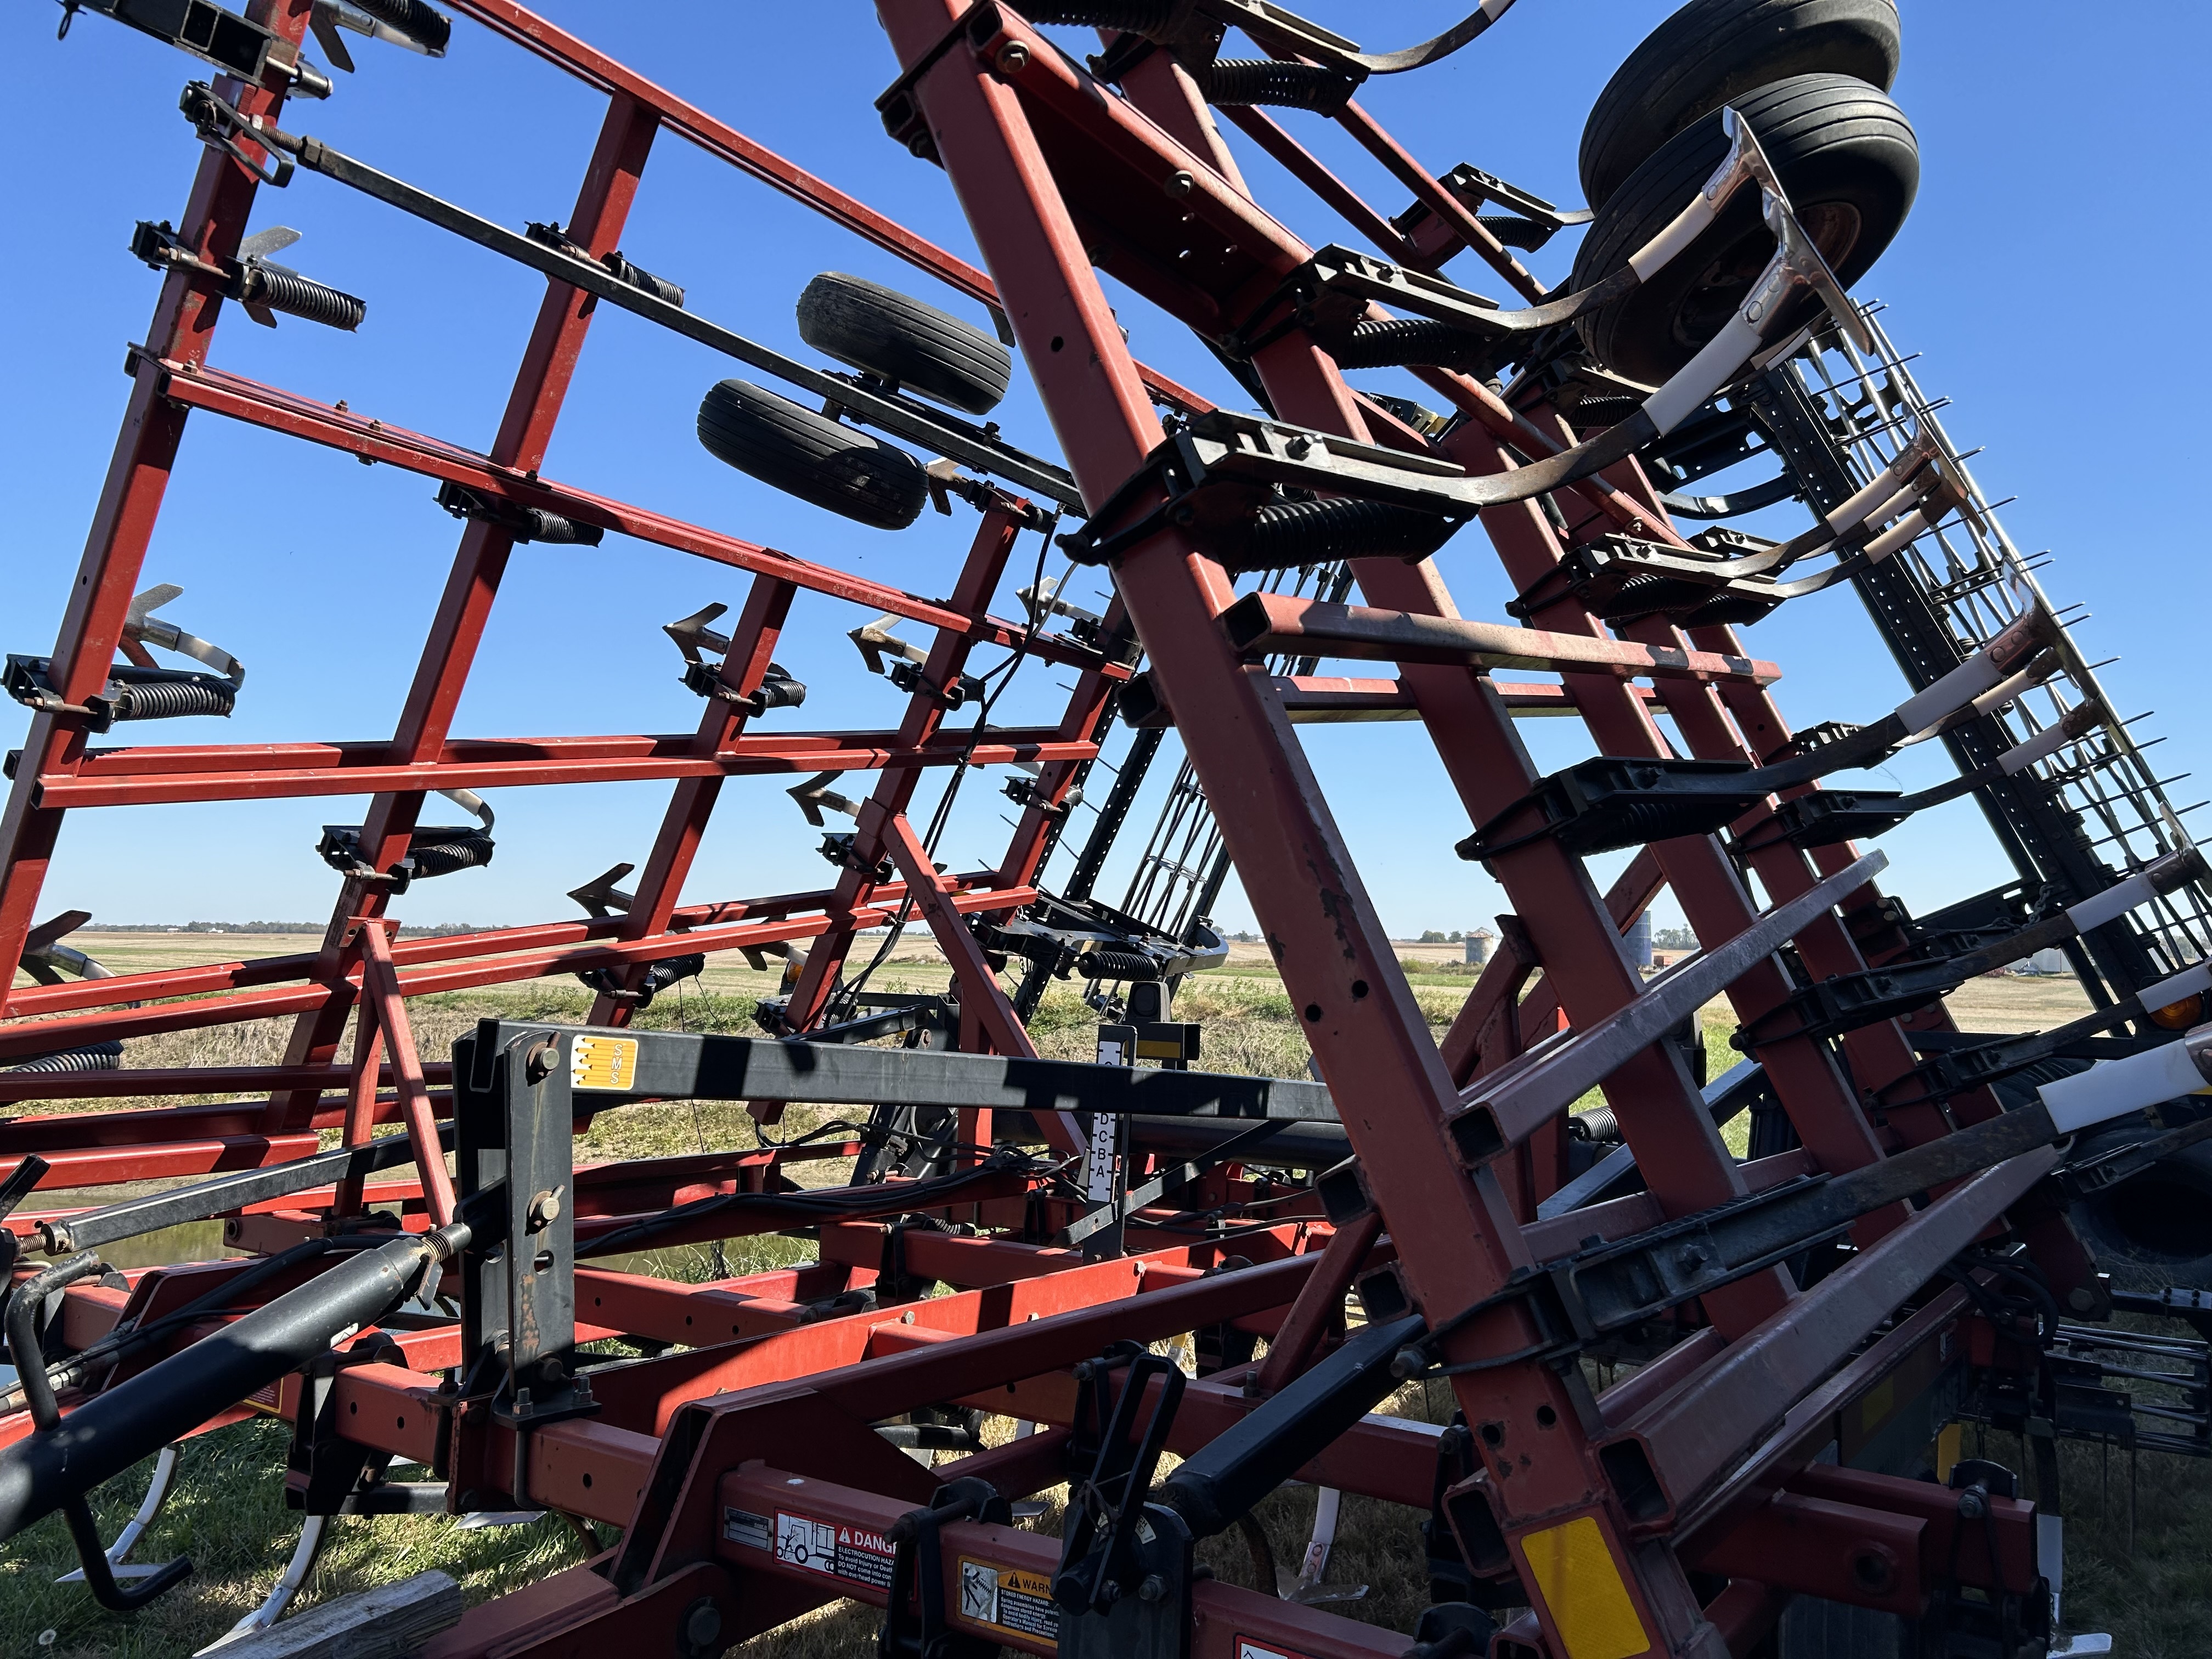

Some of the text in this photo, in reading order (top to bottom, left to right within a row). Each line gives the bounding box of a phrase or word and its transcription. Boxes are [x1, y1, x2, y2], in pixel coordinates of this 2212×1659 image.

[610, 1043, 623, 1085] SMS
[1100, 1113, 1109, 1125] D
[1099, 1130, 1108, 1143] C
[1098, 1148, 1106, 1160] B
[1096, 1165, 1104, 1178] A
[838, 1546, 881, 1562] ELECTROCUTION
[845, 1556, 858, 1564] avoid
[847, 1562, 857, 1571] NOT
[857, 1567, 871, 1575] come
[848, 1571, 871, 1582] overhead
[871, 1578, 886, 1587] power
[1001, 1589, 1016, 1598] STORED
[1017, 1593, 1032, 1602] ENERGY
